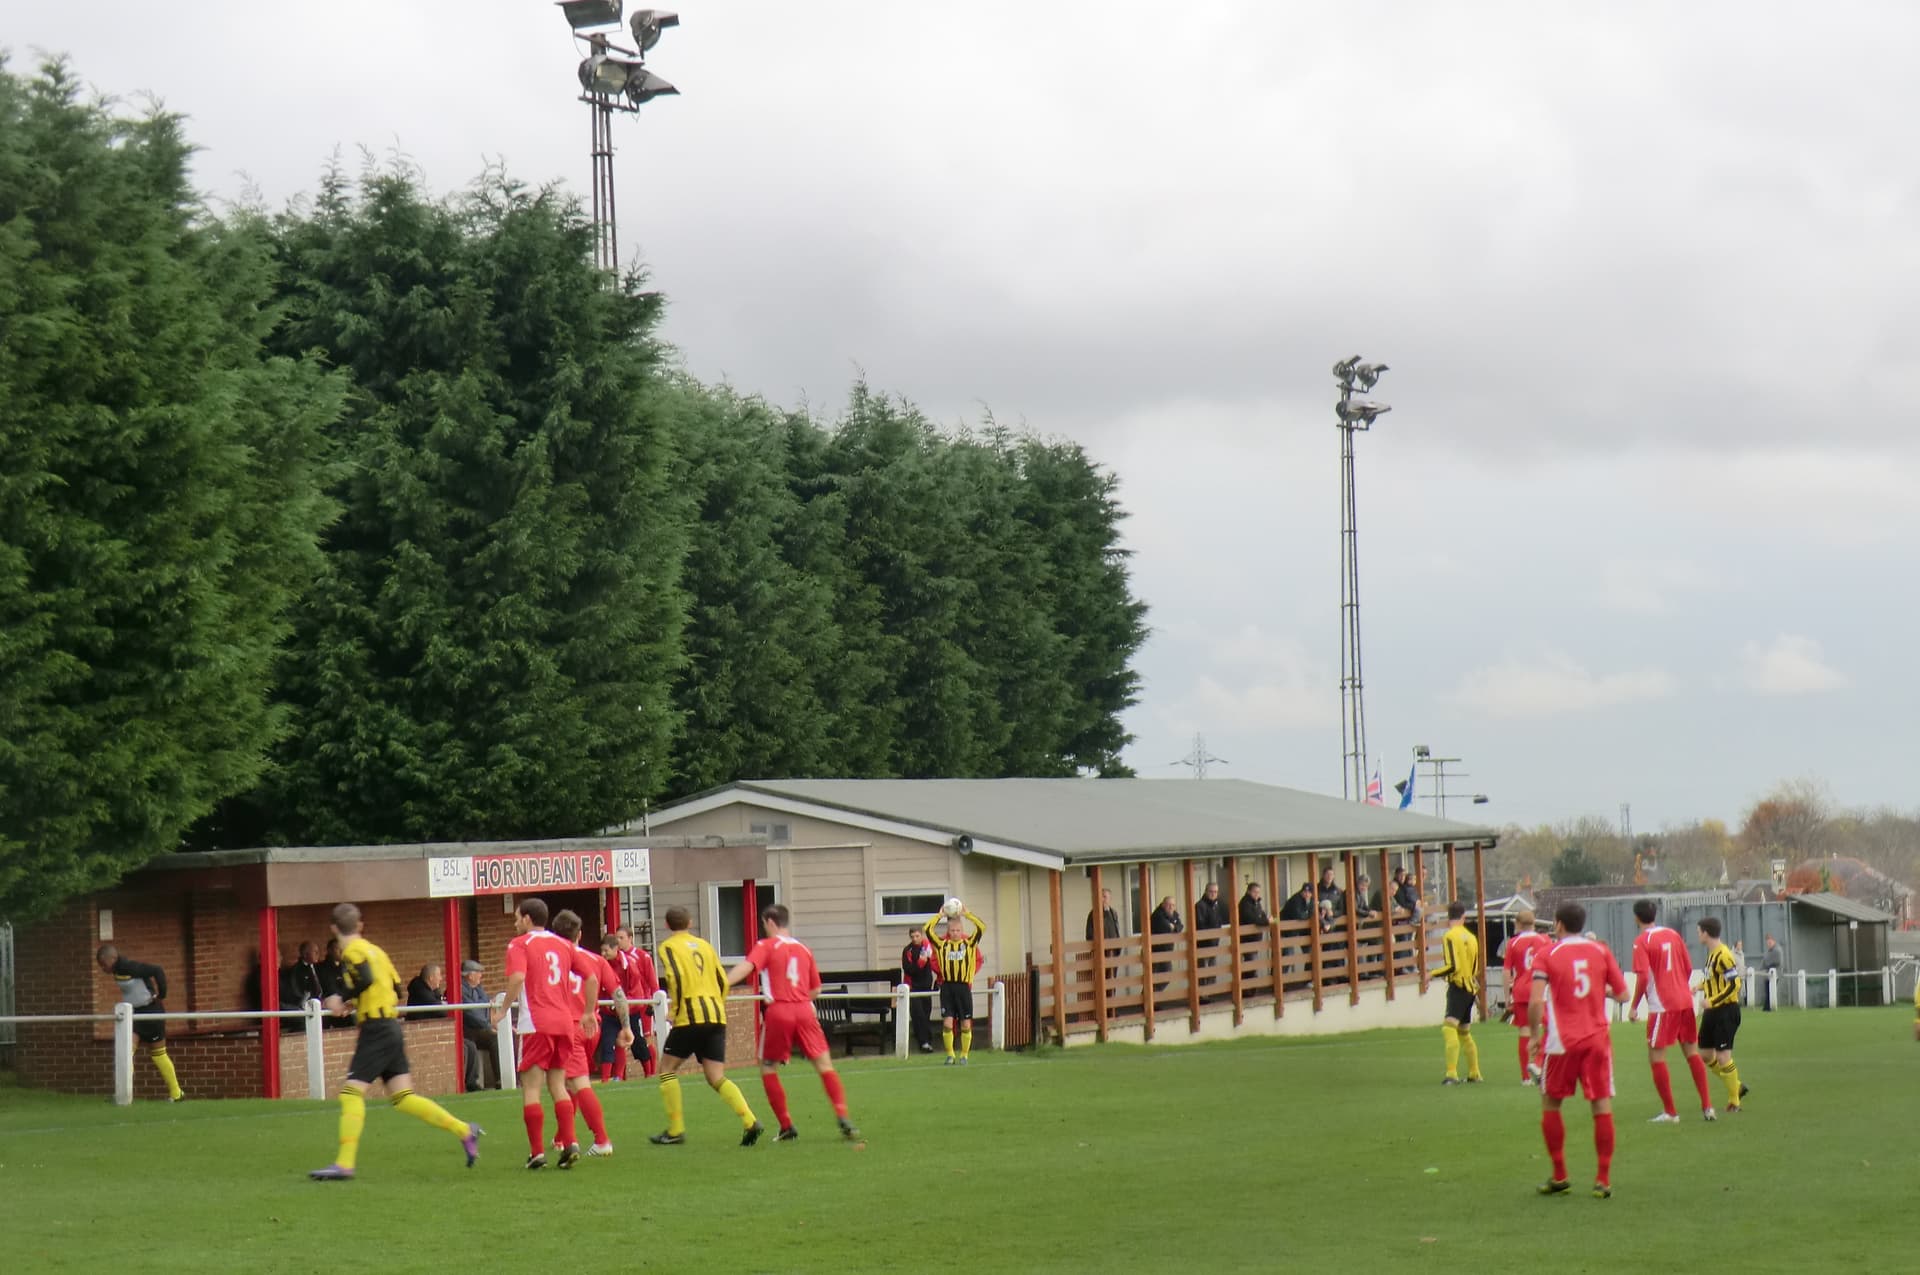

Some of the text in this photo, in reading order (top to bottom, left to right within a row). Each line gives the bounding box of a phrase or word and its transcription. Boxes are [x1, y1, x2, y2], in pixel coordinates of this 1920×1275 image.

[443, 859, 461, 877] BSL
[475, 854, 611, 889] HORNDEAN F.C.
[623, 851, 639, 868] BSL
[545, 951, 561, 986] 3
[692, 951, 704, 977] 9
[1524, 946, 1534, 970] 6
[1662, 942, 1672, 971] 7
[786, 957, 799, 987] 4
[1573, 959, 1591, 998] 5
